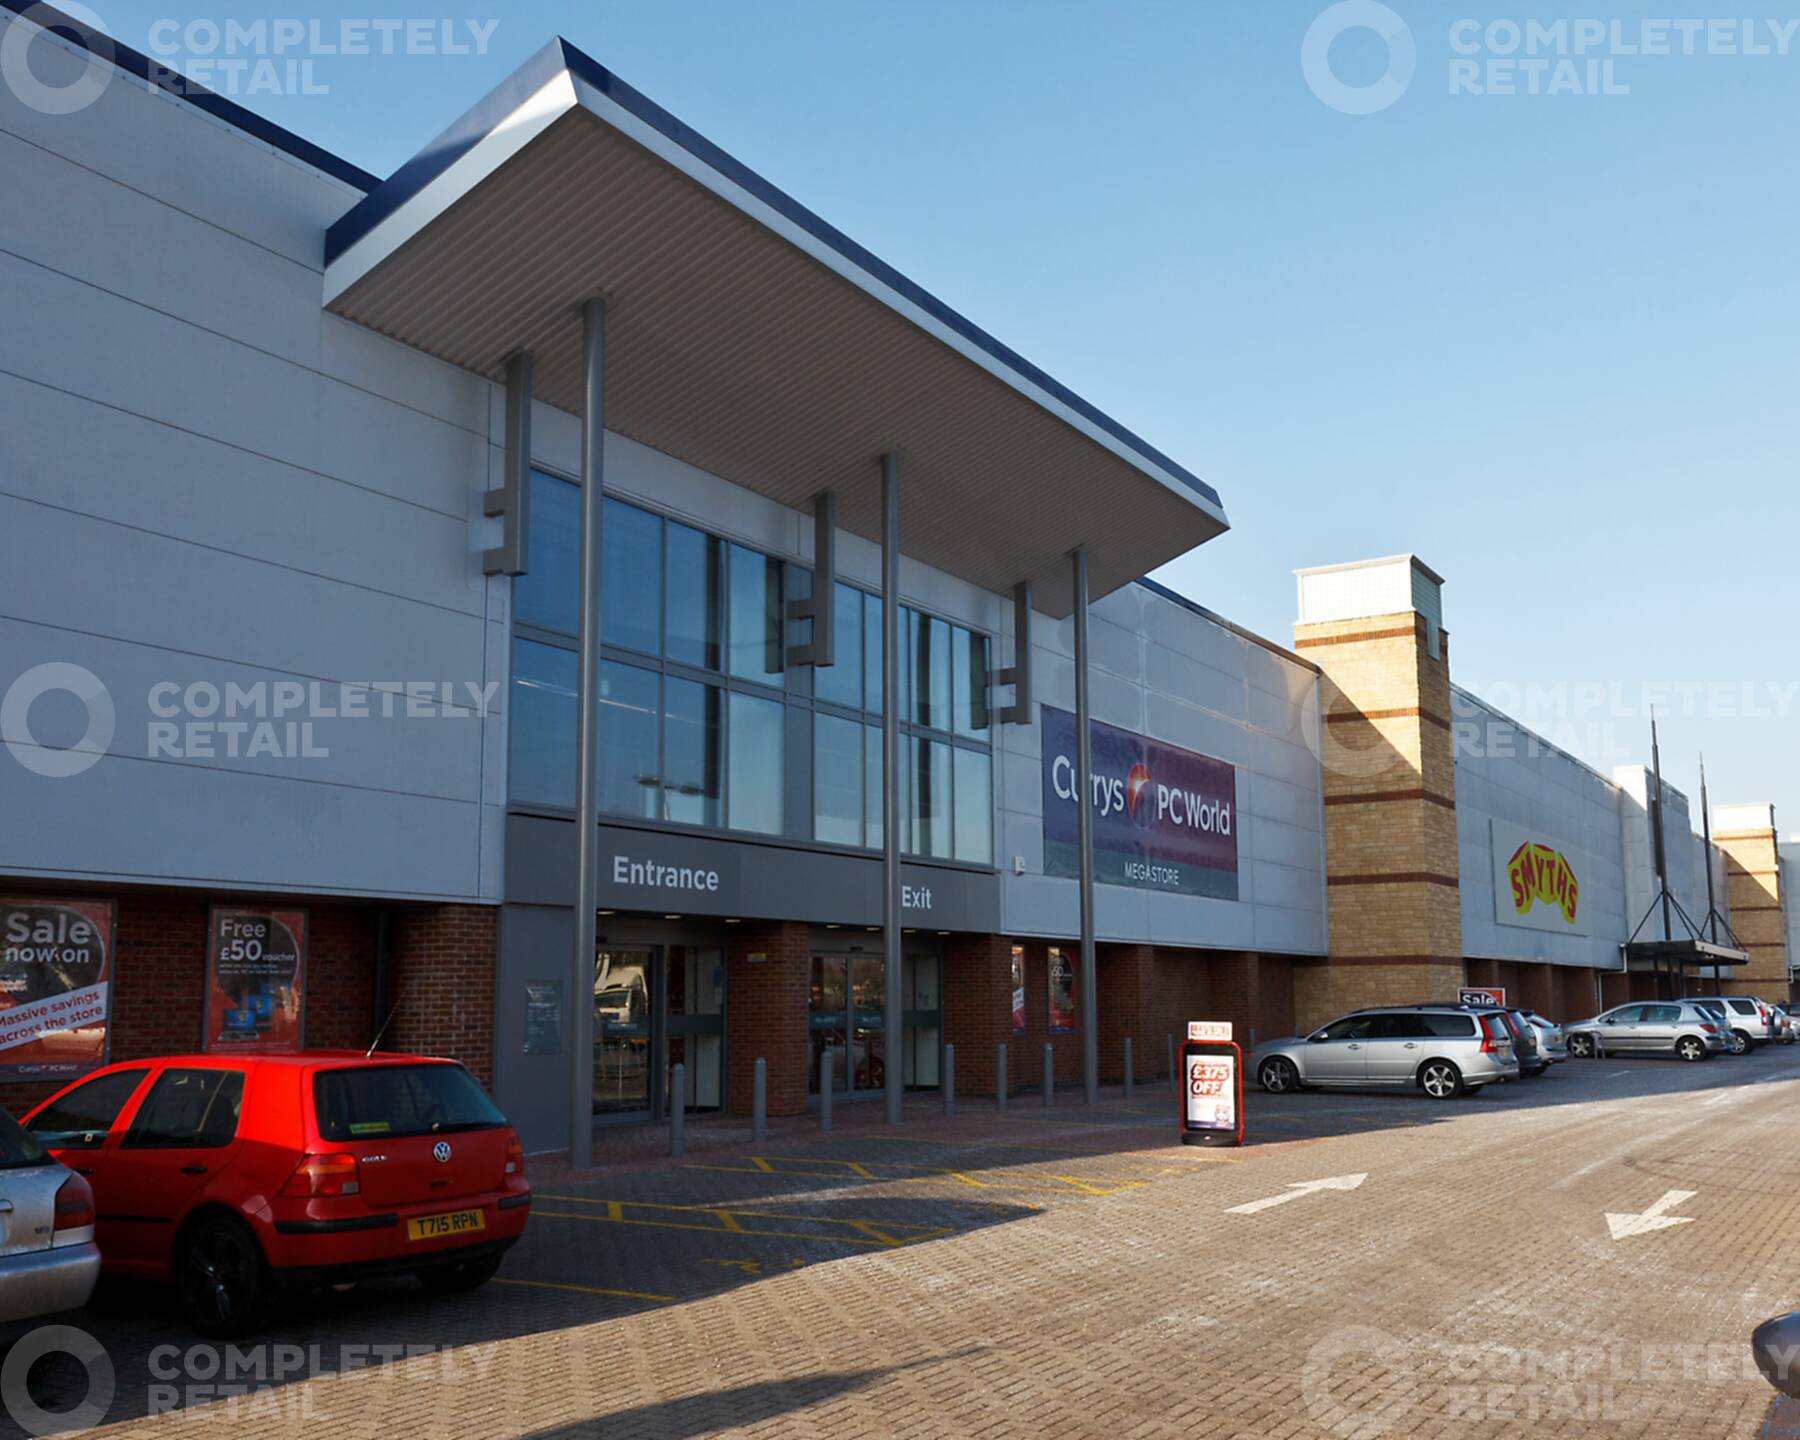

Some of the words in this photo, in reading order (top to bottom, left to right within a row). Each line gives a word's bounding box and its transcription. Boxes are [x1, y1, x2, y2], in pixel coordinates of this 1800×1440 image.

[1052, 755, 1124, 816] Curys
[613, 855, 719, 892] Entrance
[1124, 861, 1179, 885] MEGASTORE
[1509, 846, 1578, 921] SMYTHS
[901, 886, 932, 909] Exit
[5, 911, 91, 945] Sale
[220, 918, 266, 938] Free
[5, 946, 55, 963] now
[62, 948, 89, 963] on
[220, 939, 262, 961] £50
[51, 991, 100, 1013] savings
[1462, 994, 1494, 1005] Sale
[0, 1024, 42, 1044] across
[45, 1015, 66, 1031] the
[70, 1006, 103, 1023] store
[1191, 1063, 1229, 1079] £375
[1191, 1080, 1222, 1096] OFF
[417, 1215, 449, 1235] T715
[452, 1212, 478, 1233] RPN
